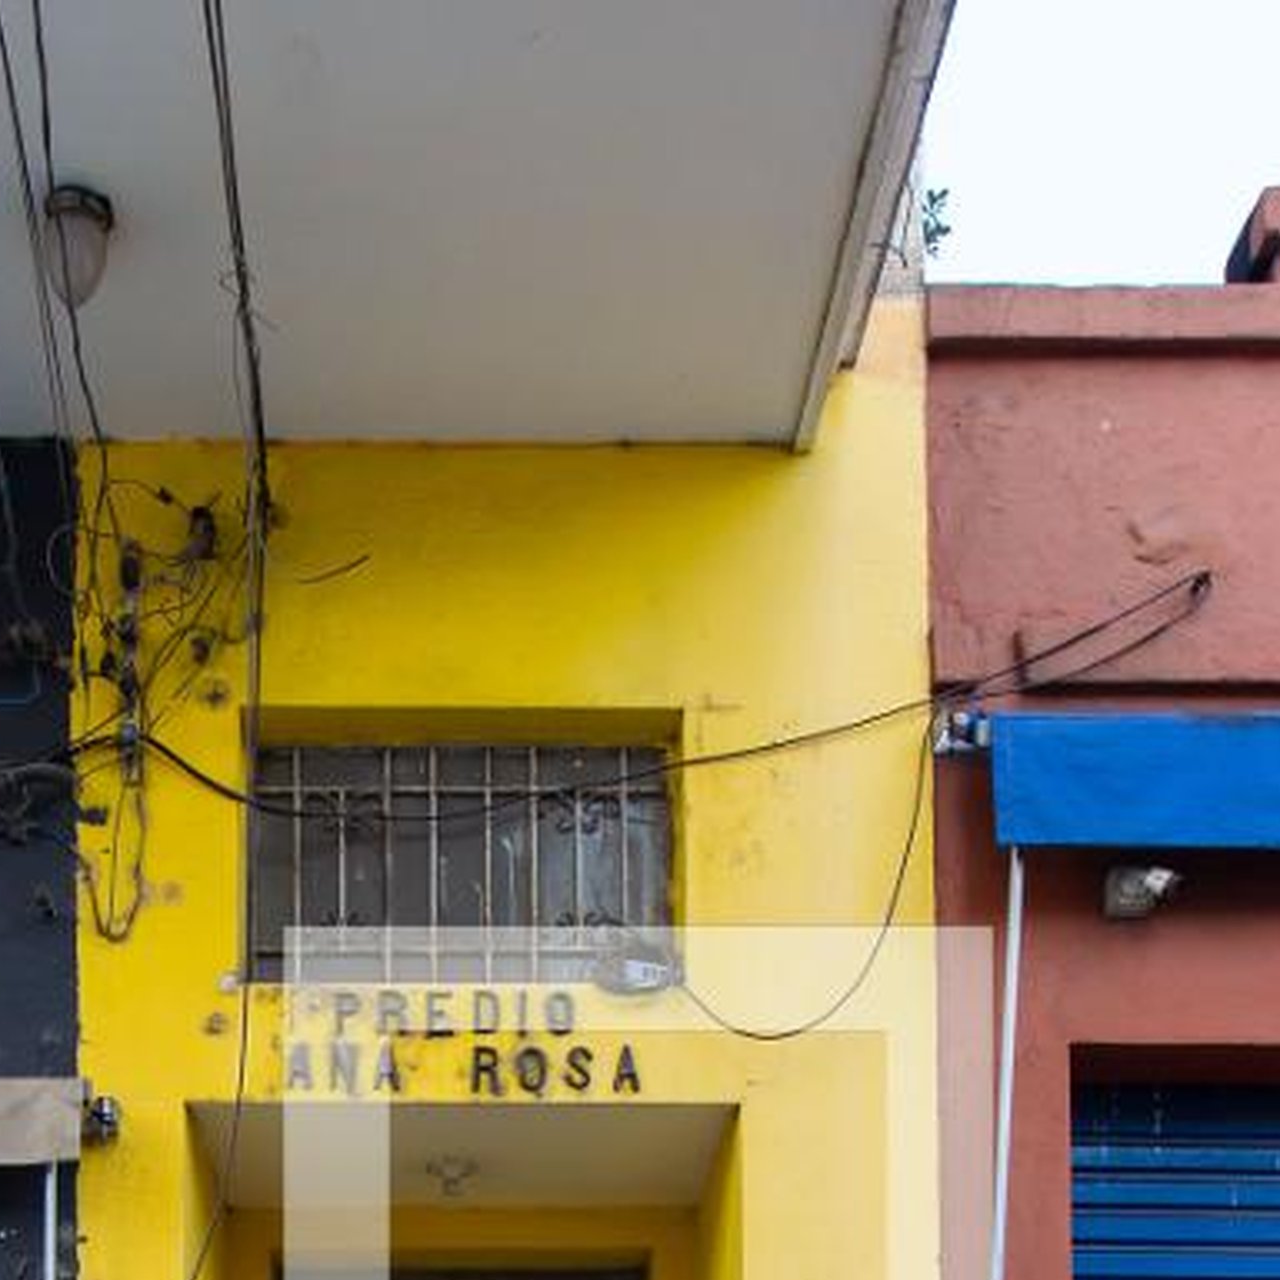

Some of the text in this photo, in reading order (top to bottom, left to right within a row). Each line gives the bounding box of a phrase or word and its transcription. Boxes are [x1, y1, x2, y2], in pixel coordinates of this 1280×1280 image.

[333, 989, 575, 1038] PREDIO
[287, 1039, 641, 1096] ANA ROSA
